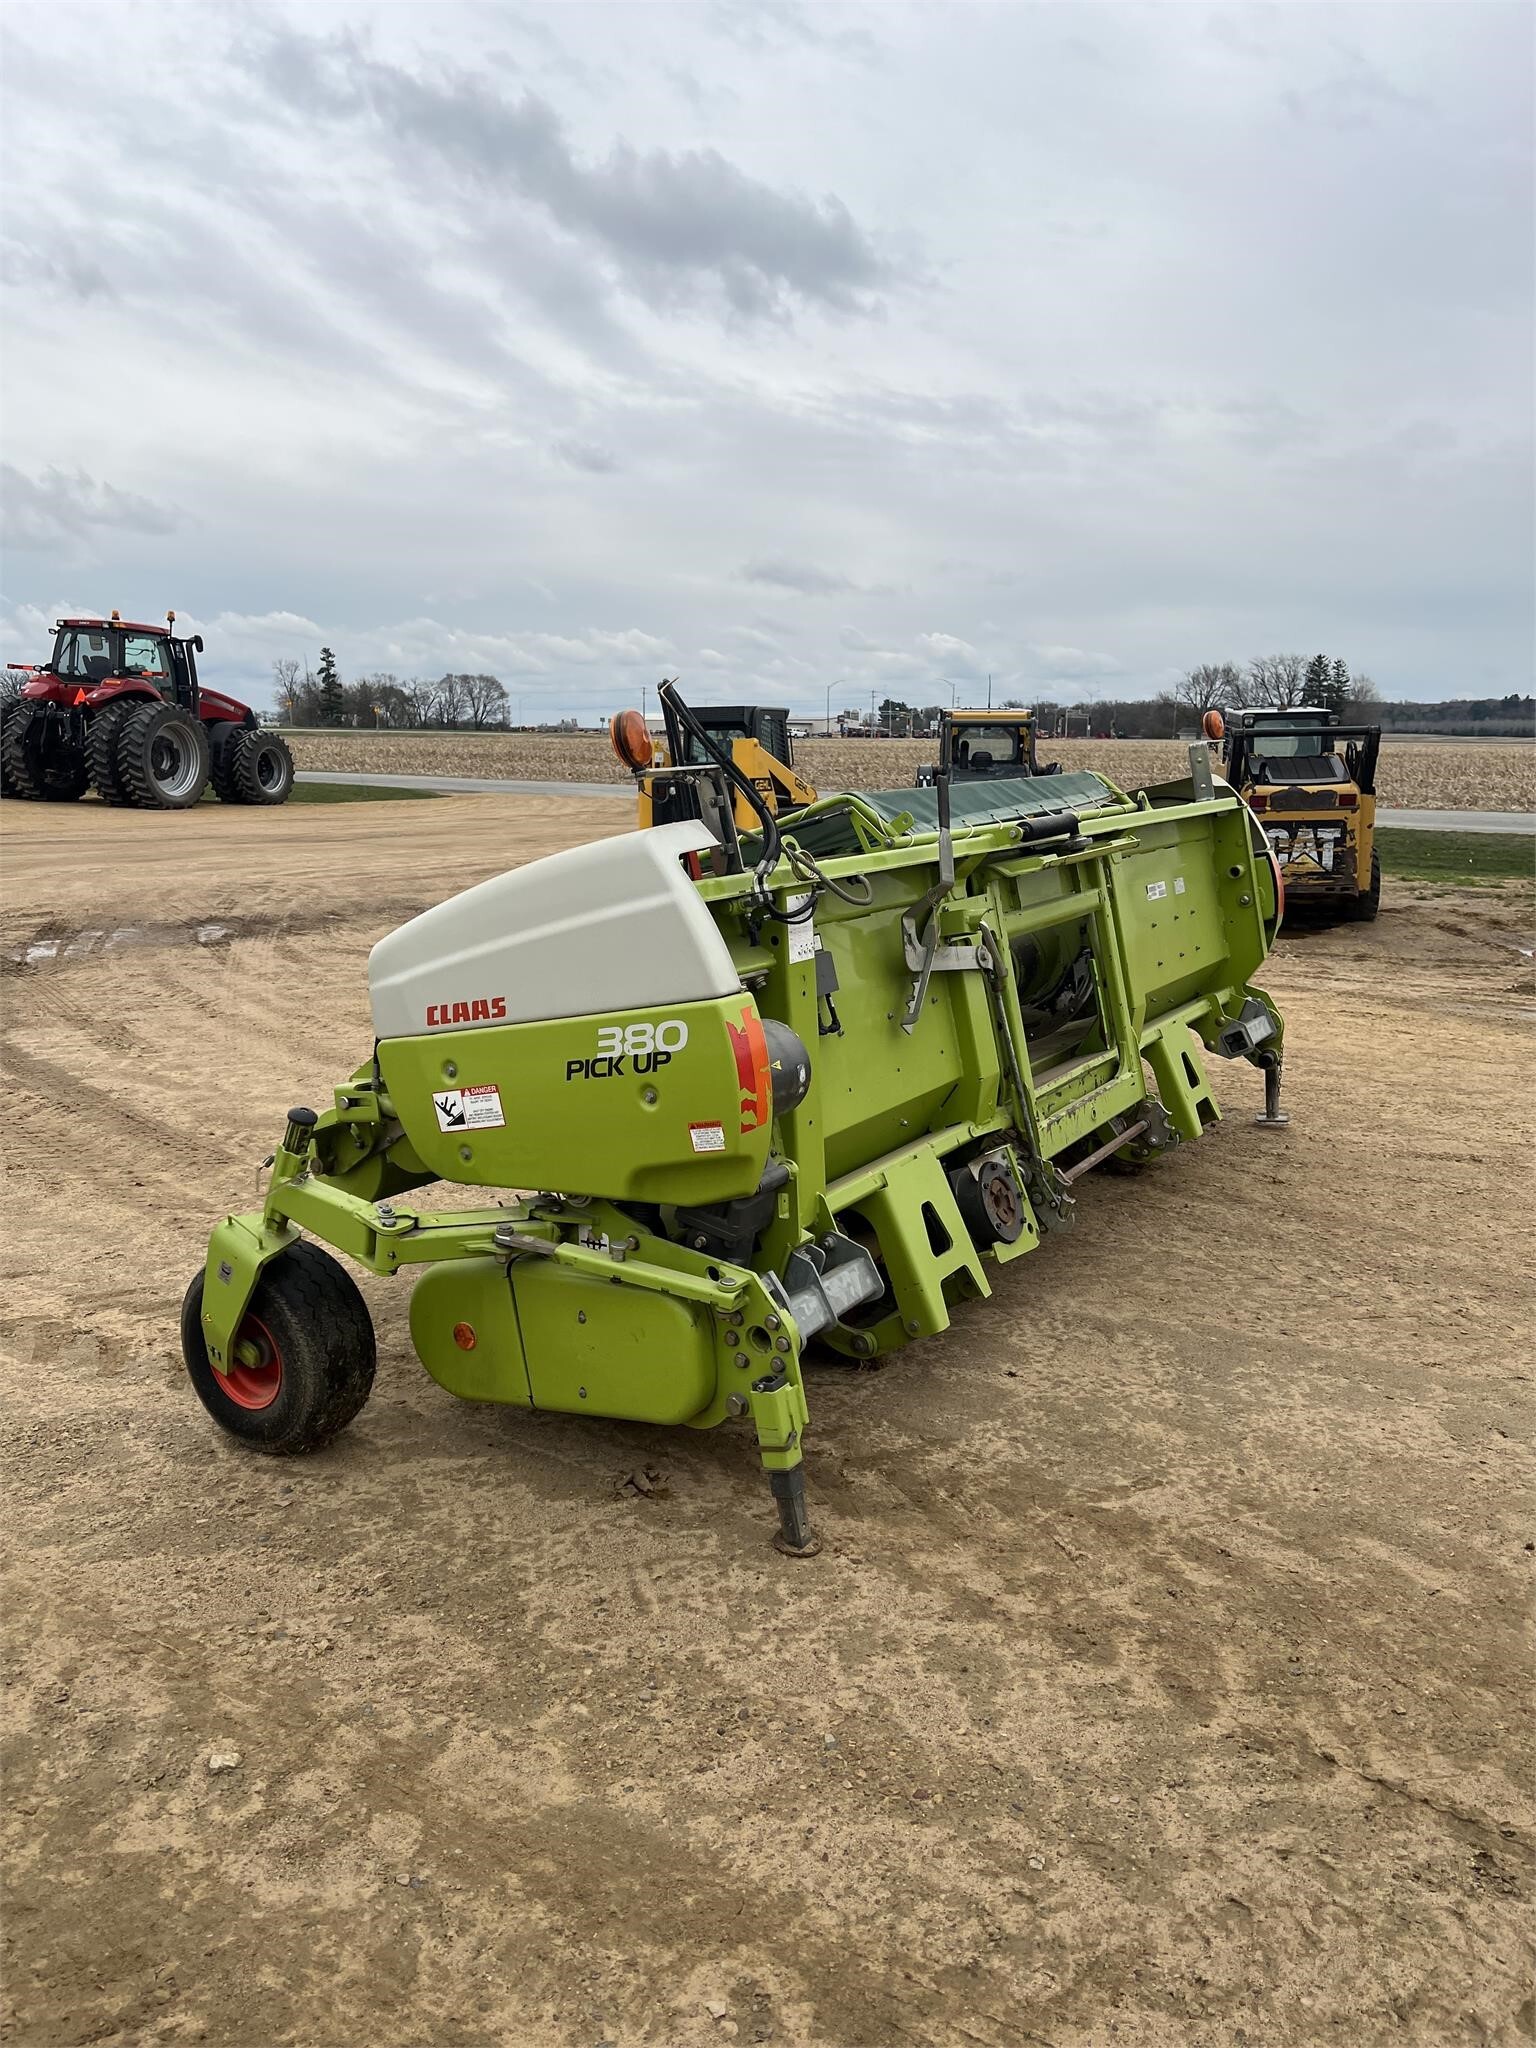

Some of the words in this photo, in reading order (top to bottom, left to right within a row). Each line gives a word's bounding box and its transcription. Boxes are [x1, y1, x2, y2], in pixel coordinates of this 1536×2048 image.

[426, 996, 506, 1026] CLAAS
[597, 1020, 689, 1059] 380
[566, 1055, 625, 1081] PICK
[633, 1051, 672, 1074] UP
[470, 1085, 497, 1095] DANGER
